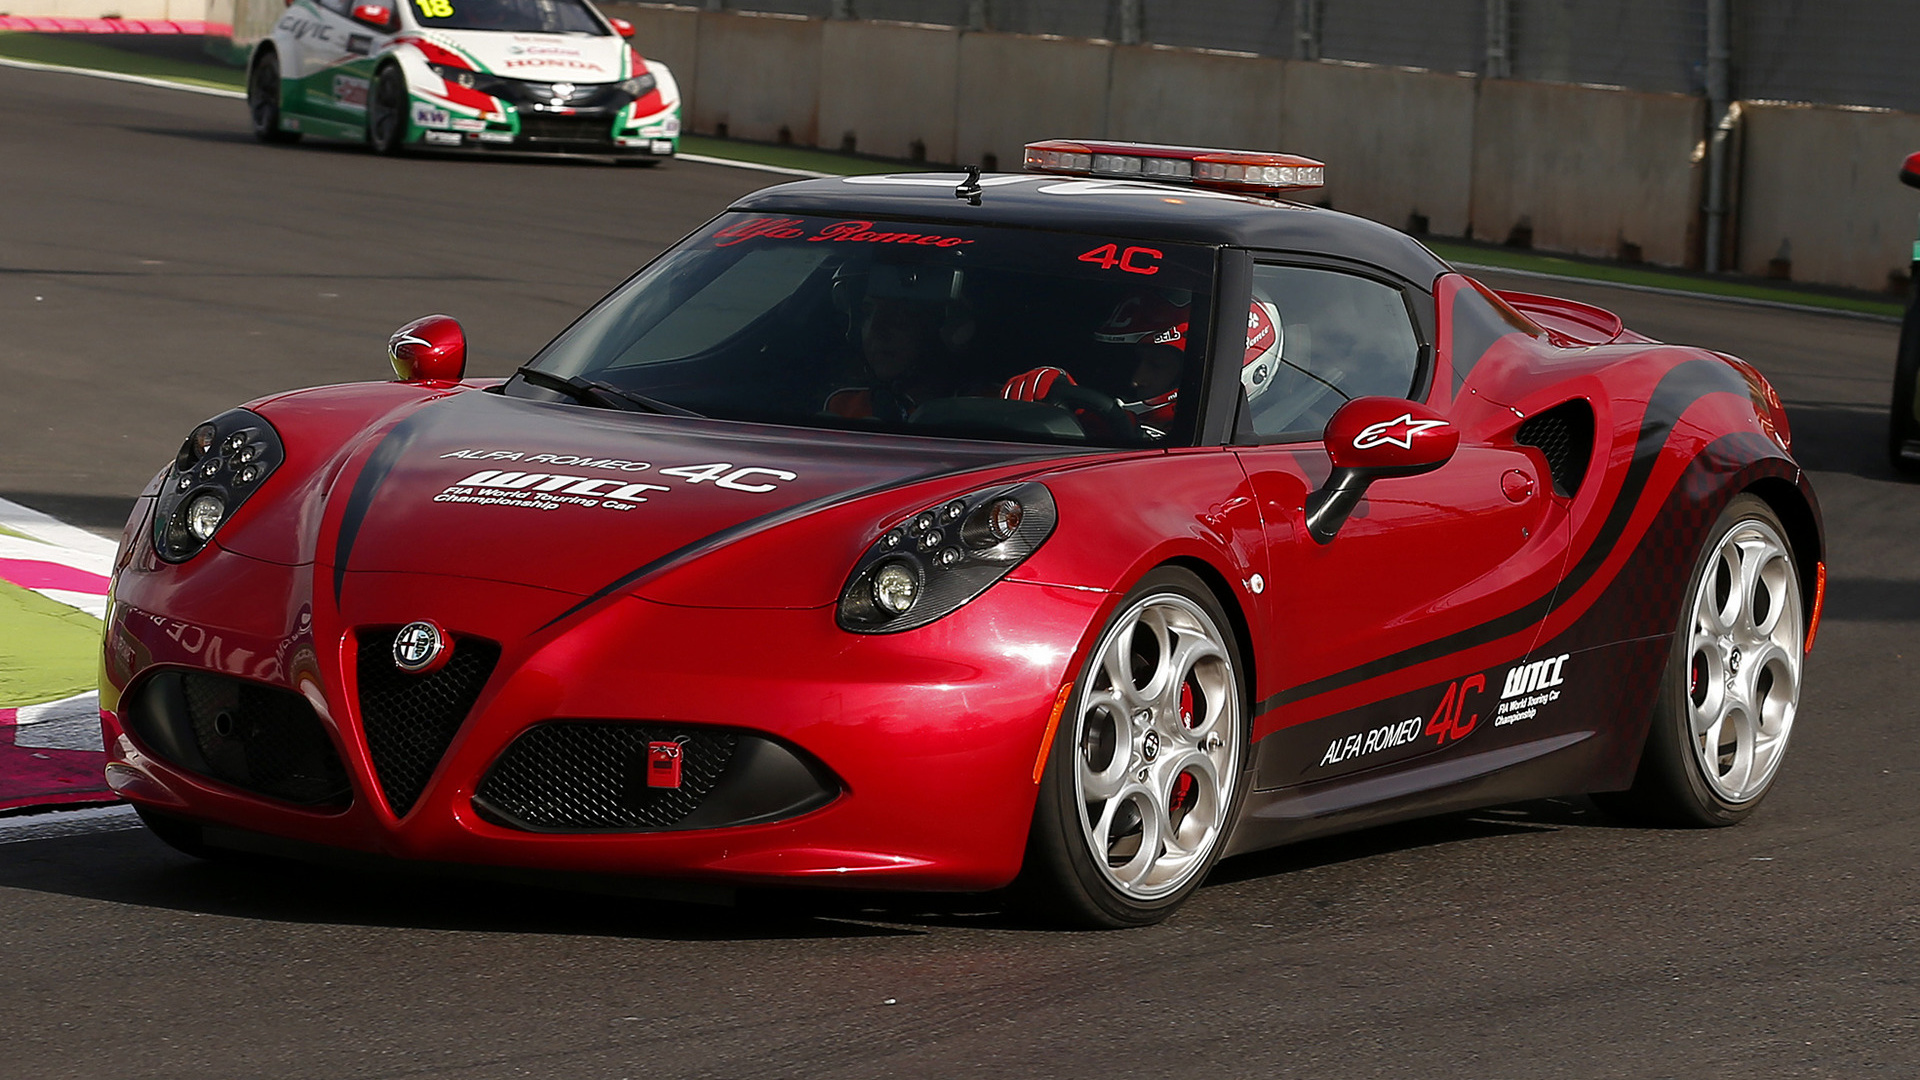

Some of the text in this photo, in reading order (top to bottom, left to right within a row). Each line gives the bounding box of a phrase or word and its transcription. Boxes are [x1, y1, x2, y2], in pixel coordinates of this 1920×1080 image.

[416, 0, 455, 18] 18
[504, 58, 606, 73] HONDA
[712, 218, 975, 247] Alfa Romeo
[1077, 244, 1163, 276] 4C
[439, 449, 798, 493] ALFA ROMEO 4C
[442, 486, 637, 511] FIA World Touring Car
[455, 470, 671, 502] WTCC
[433, 493, 560, 511] Championship
[1500, 653, 1570, 700] WTCC
[1497, 689, 1561, 715] FIA World Touring Car
[1319, 673, 1486, 767] ALFA ROMEO 4C
[1494, 706, 1537, 727] Championship
